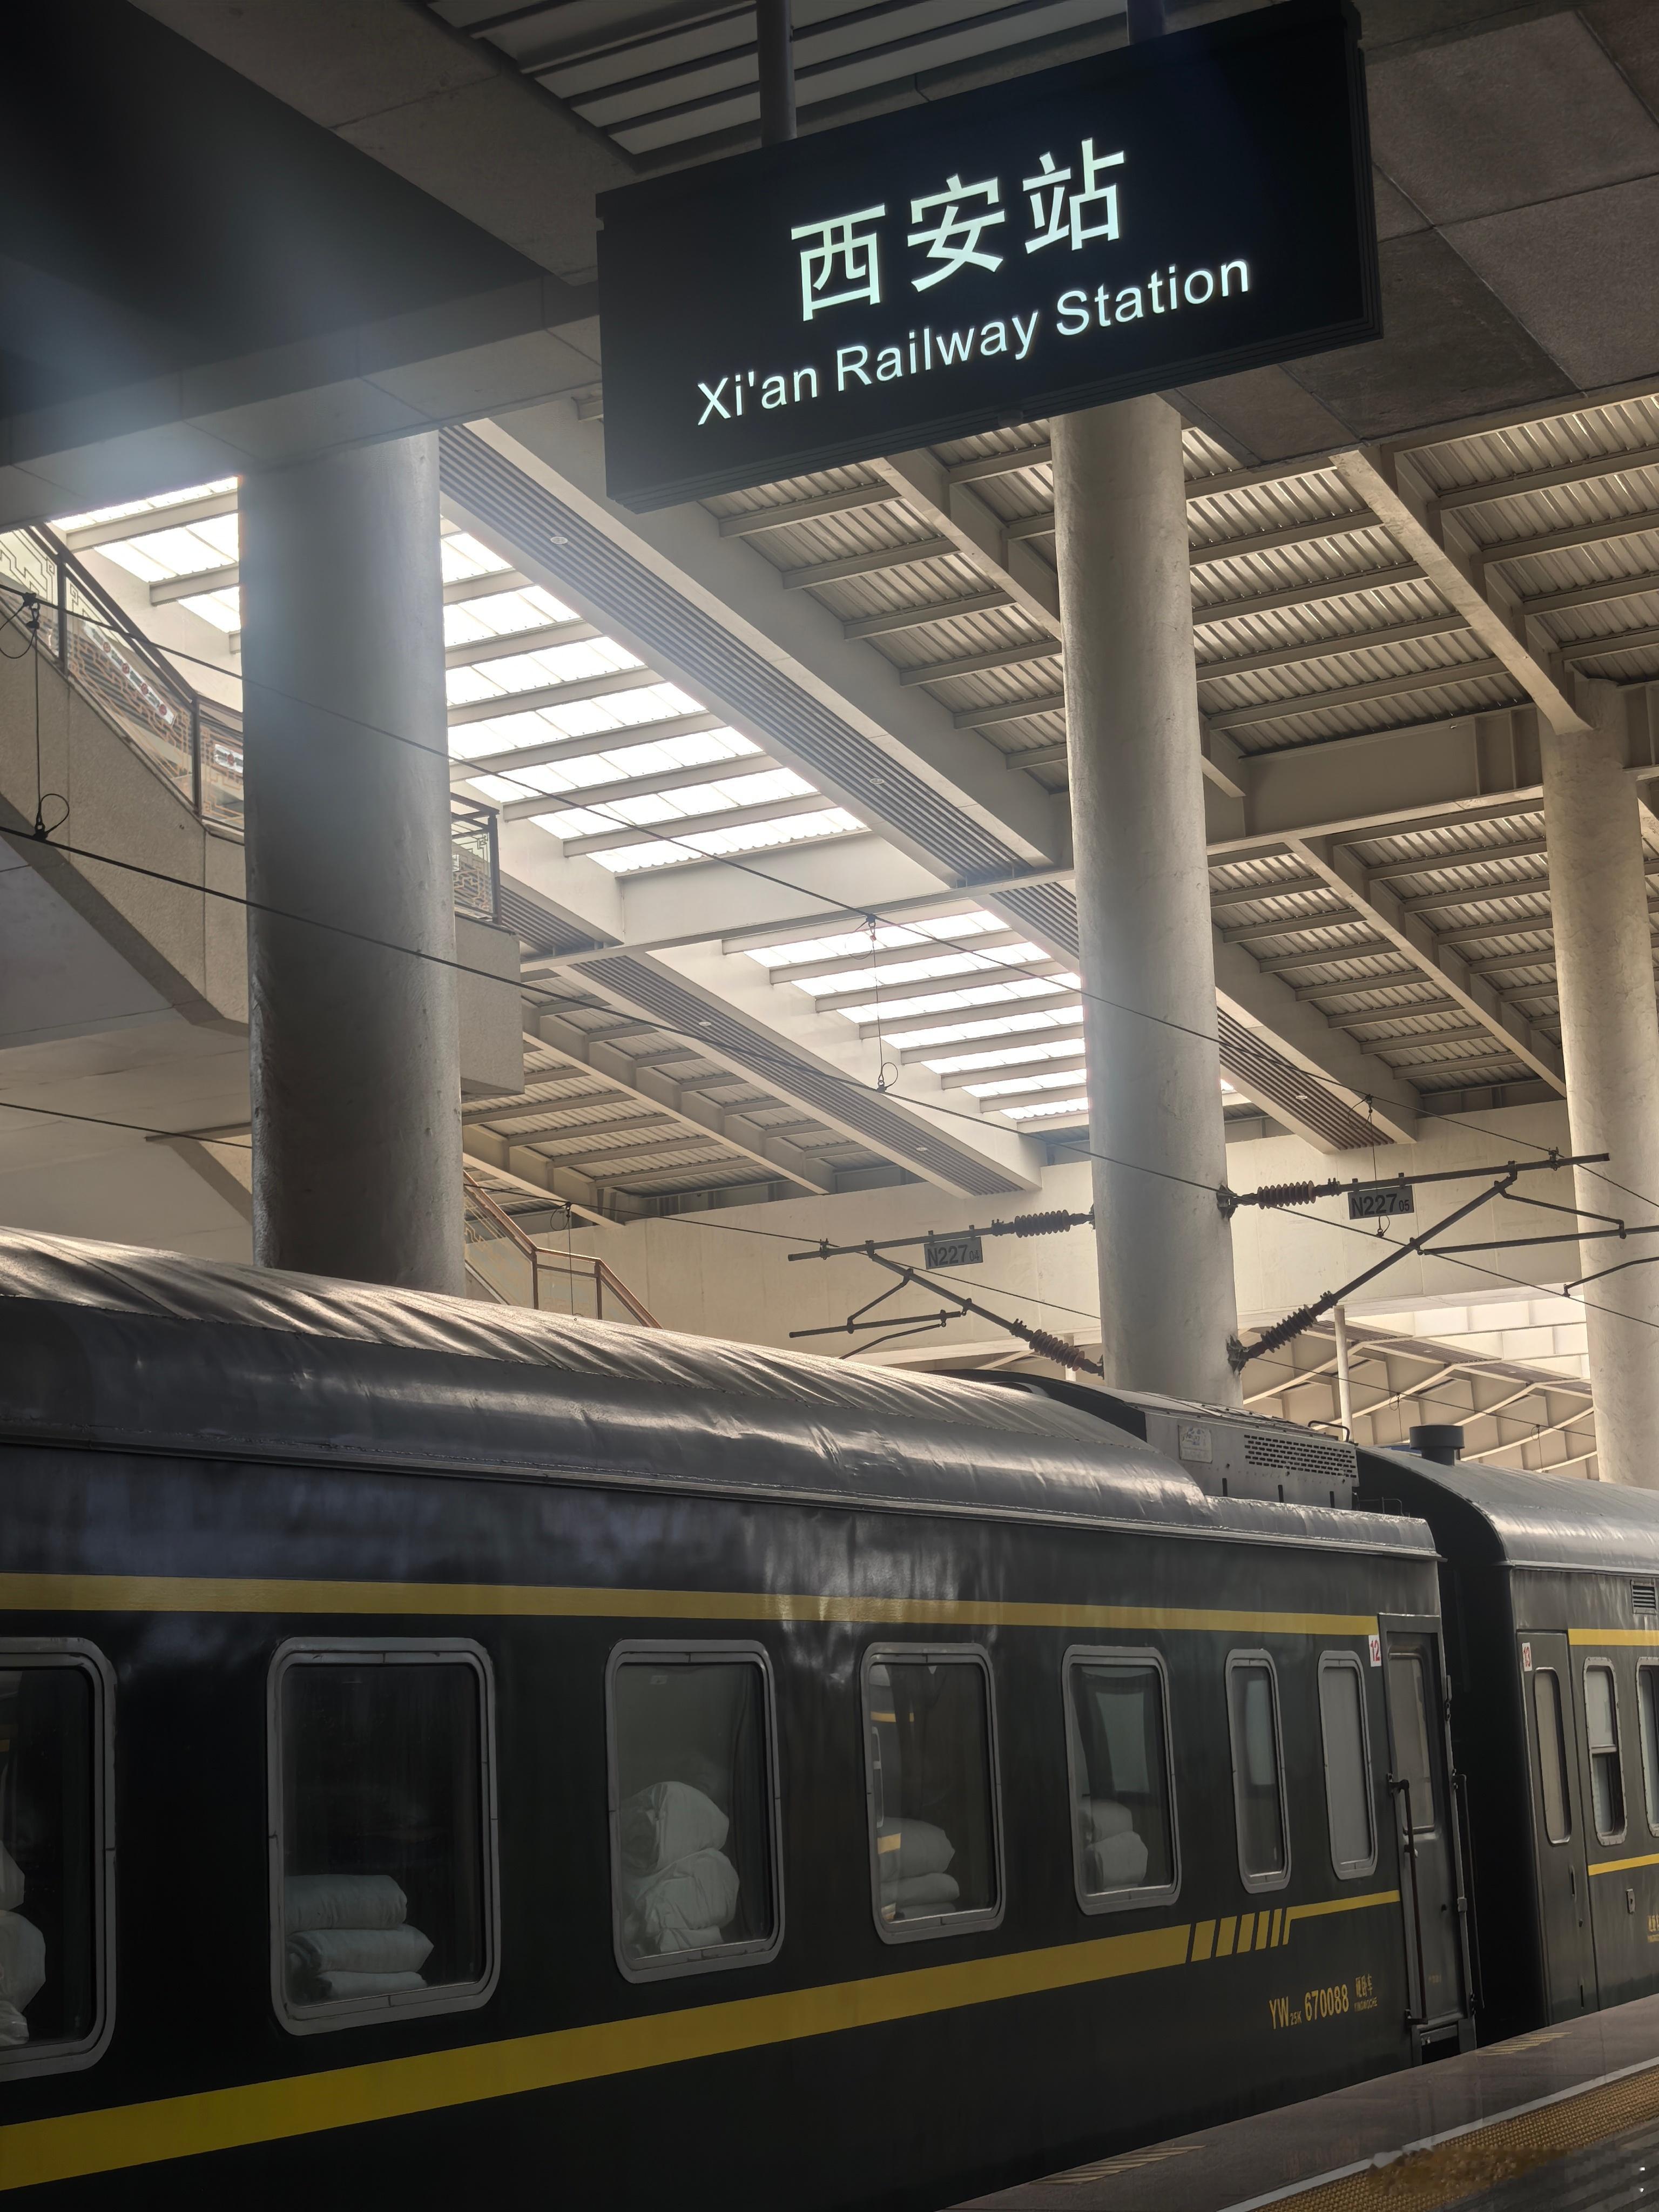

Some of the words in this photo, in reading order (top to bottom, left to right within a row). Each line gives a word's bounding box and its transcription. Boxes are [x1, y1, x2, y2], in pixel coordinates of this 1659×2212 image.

[791, 137, 1125, 322] 西安站
[697, 367, 818, 426] Xi'an
[837, 310, 1039, 392] Railway
[1056, 258, 1249, 335] Station
[1351, 1193, 1397, 1217] N227
[927, 1244, 968, 1267] N227
[1370, 1640, 1380, 1662] 12
[1523, 1646, 1531, 1668] 13
[1304, 1984, 1349, 2021] 670088
